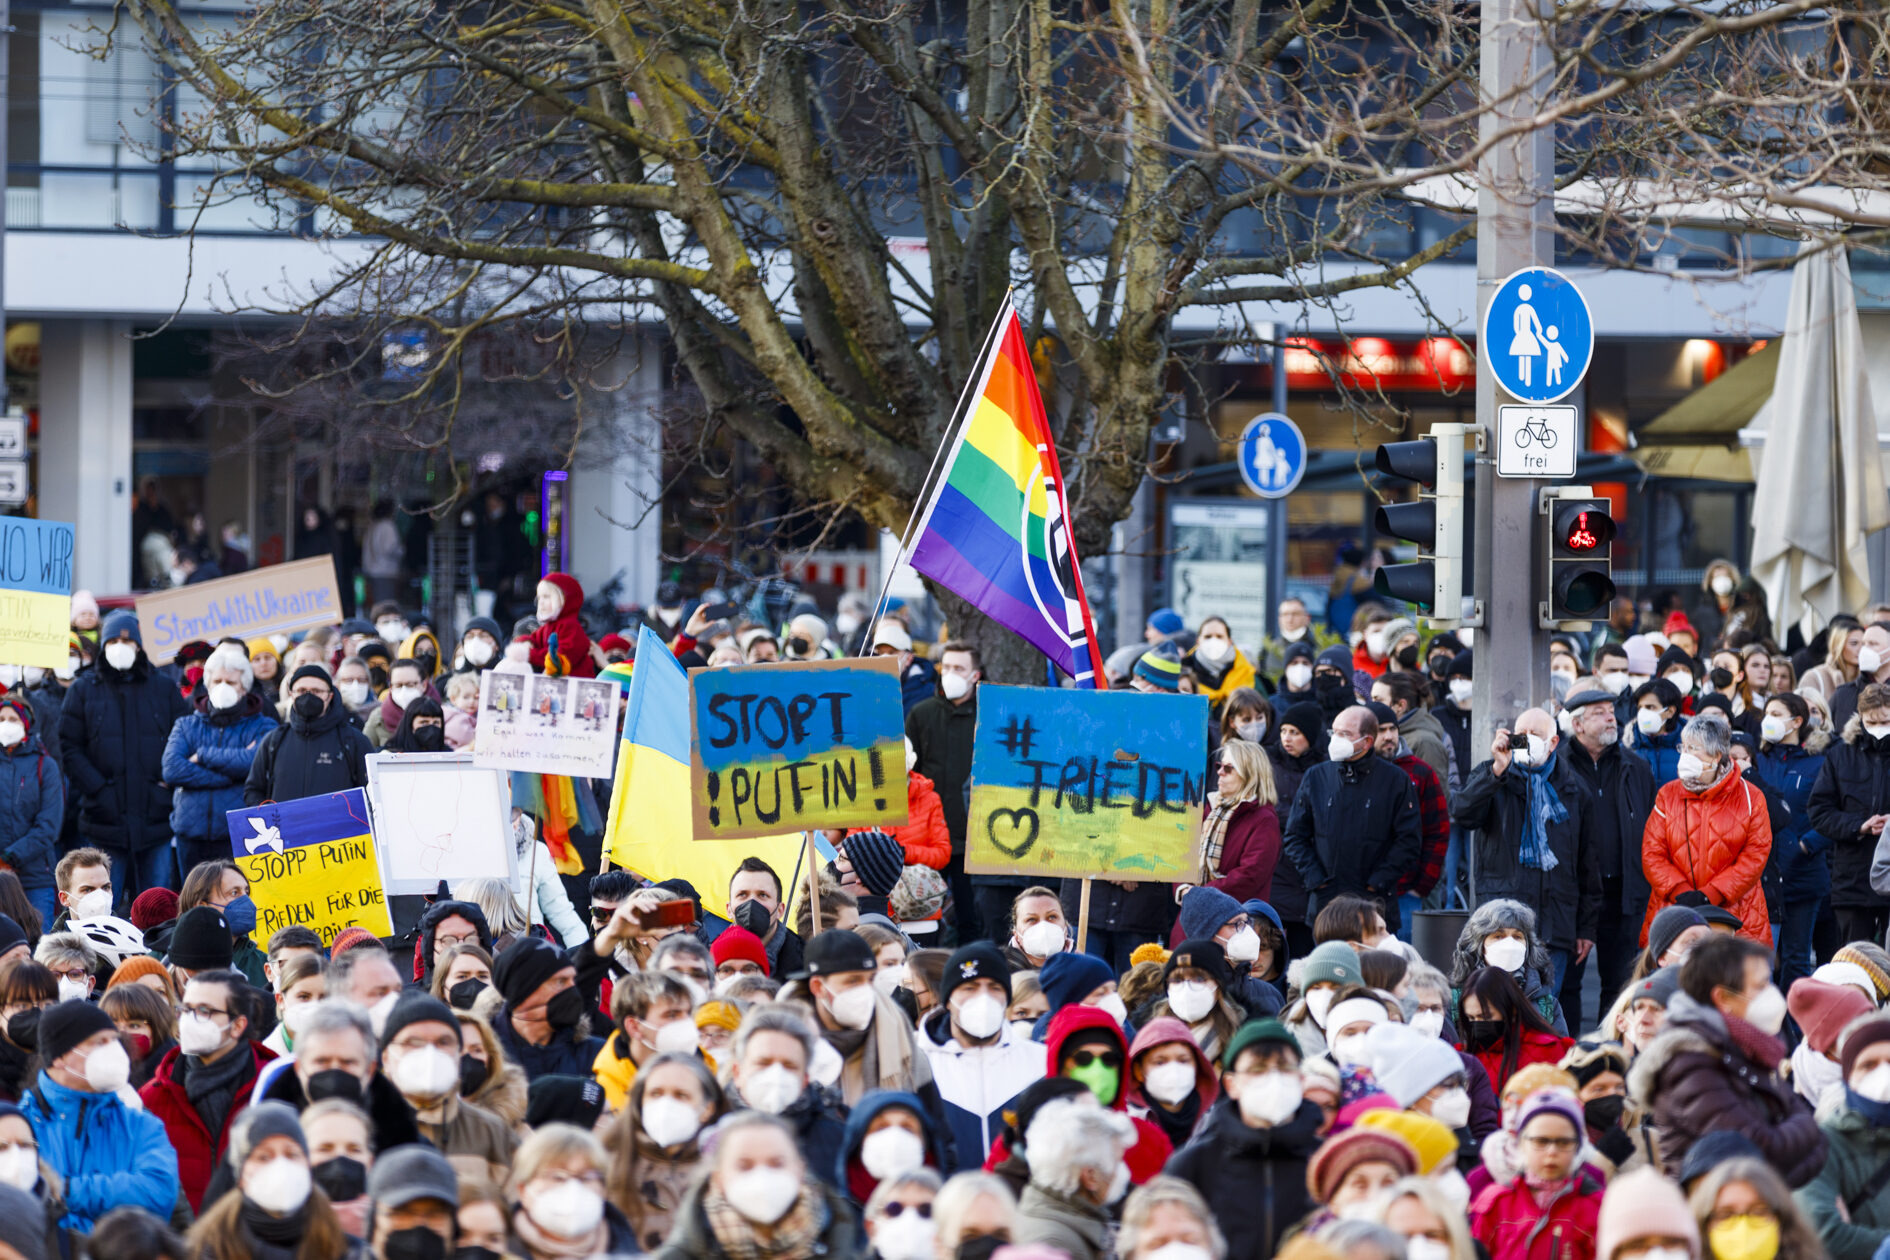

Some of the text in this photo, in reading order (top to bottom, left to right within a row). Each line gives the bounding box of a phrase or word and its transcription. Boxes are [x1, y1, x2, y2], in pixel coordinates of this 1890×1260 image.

[1524, 452, 1548, 468] frei
[37, 525, 74, 591] WAR
[994, 714, 1042, 759] #
[248, 848, 307, 883] STOPP
